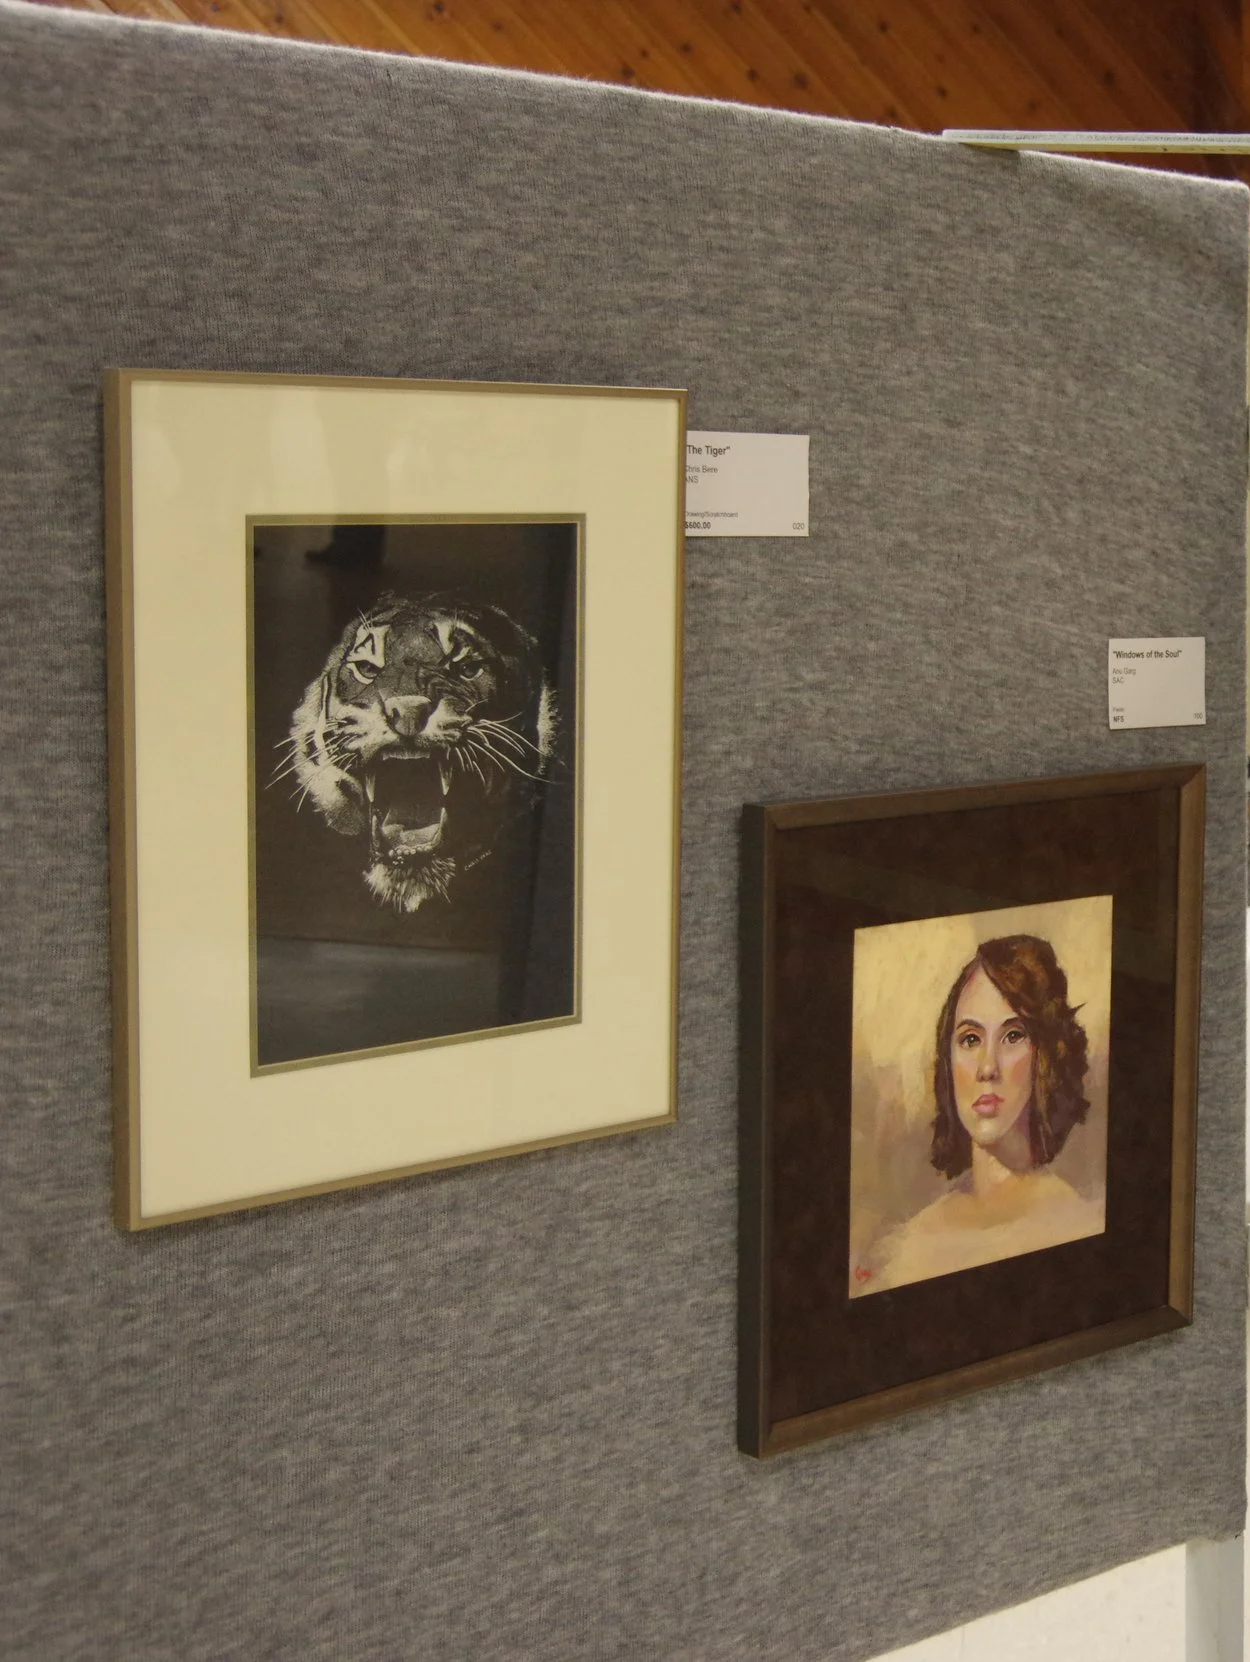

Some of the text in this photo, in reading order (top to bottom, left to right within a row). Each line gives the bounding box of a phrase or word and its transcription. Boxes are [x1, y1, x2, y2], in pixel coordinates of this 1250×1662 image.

[705, 446, 730, 457] Tiger"
[1113, 651, 1144, 659] "Windows
[1165, 650, 1182, 658] Soul"
